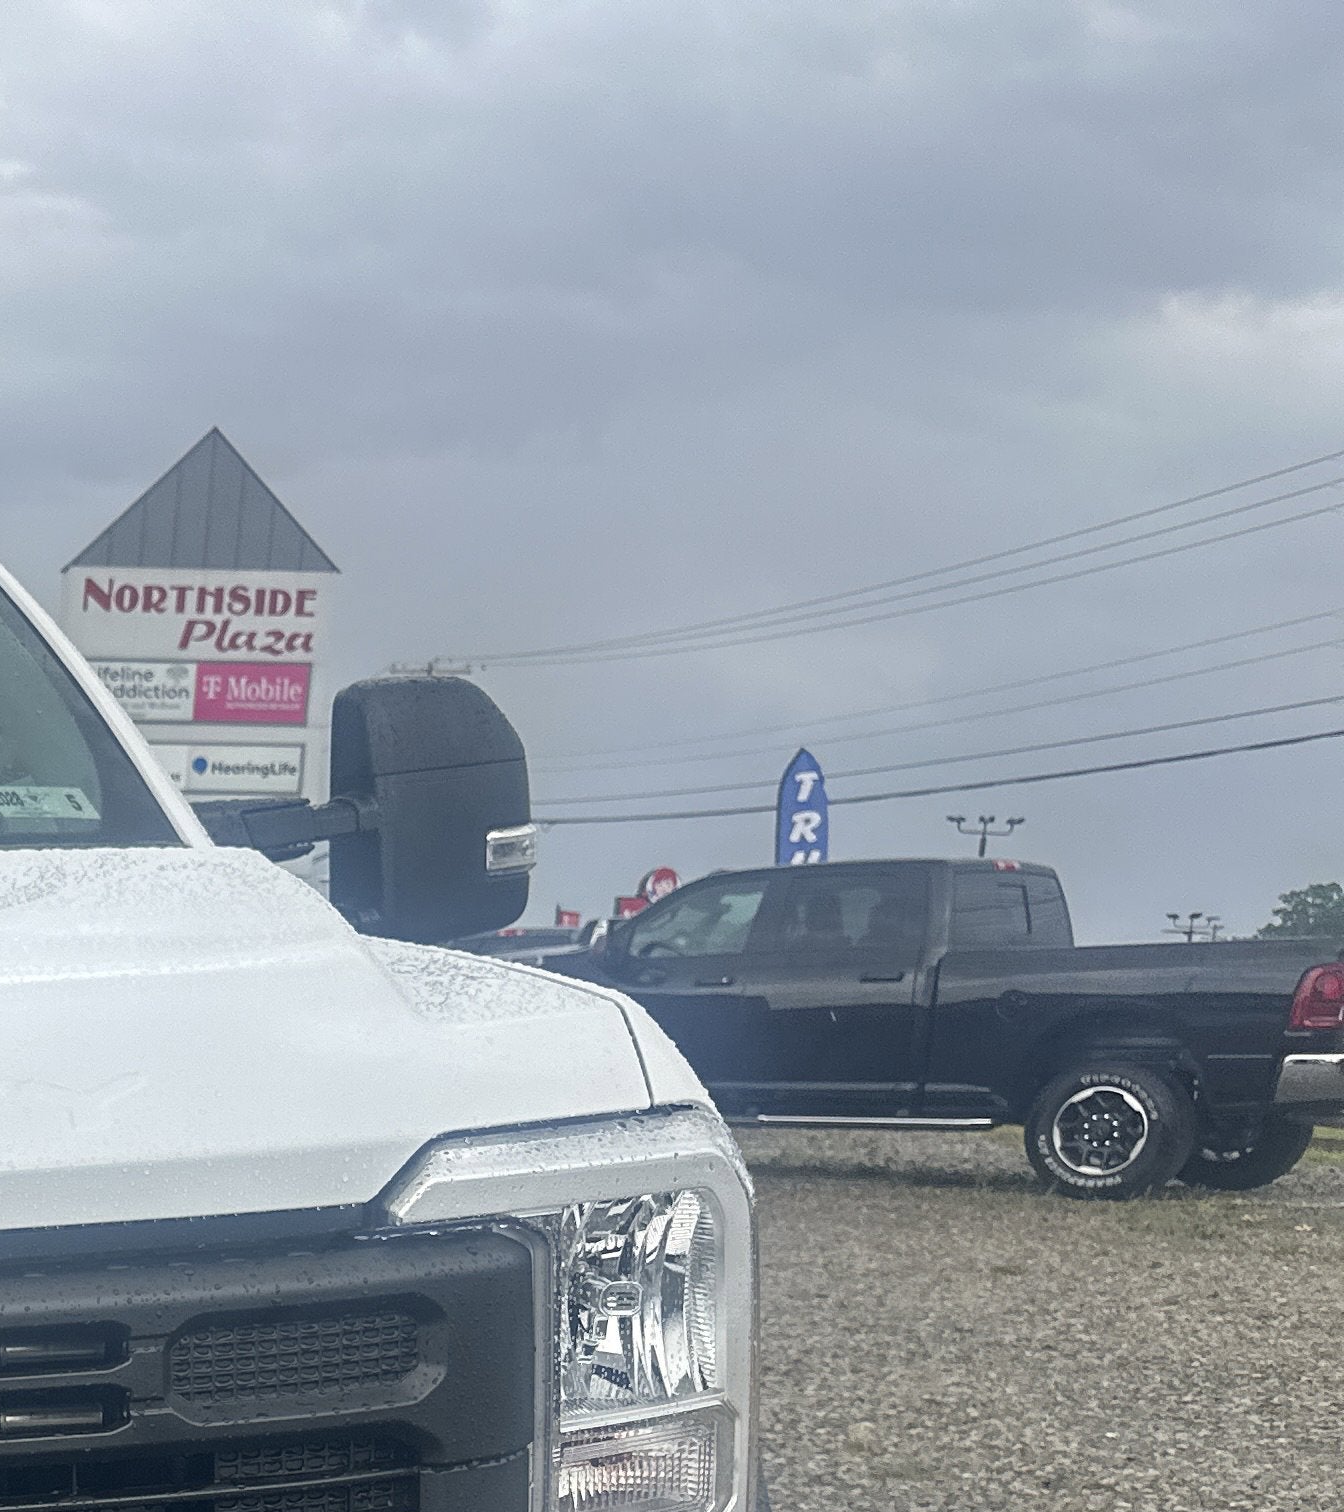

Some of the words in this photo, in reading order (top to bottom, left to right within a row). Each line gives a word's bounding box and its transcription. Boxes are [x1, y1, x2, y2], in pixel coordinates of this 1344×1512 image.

[82, 577, 317, 617] NORTHSIDE
[177, 618, 315, 656] Plaza
[96, 666, 154, 682] ifeline
[227, 676, 303, 702] Mobile
[211, 761, 297, 779] HearingLife
